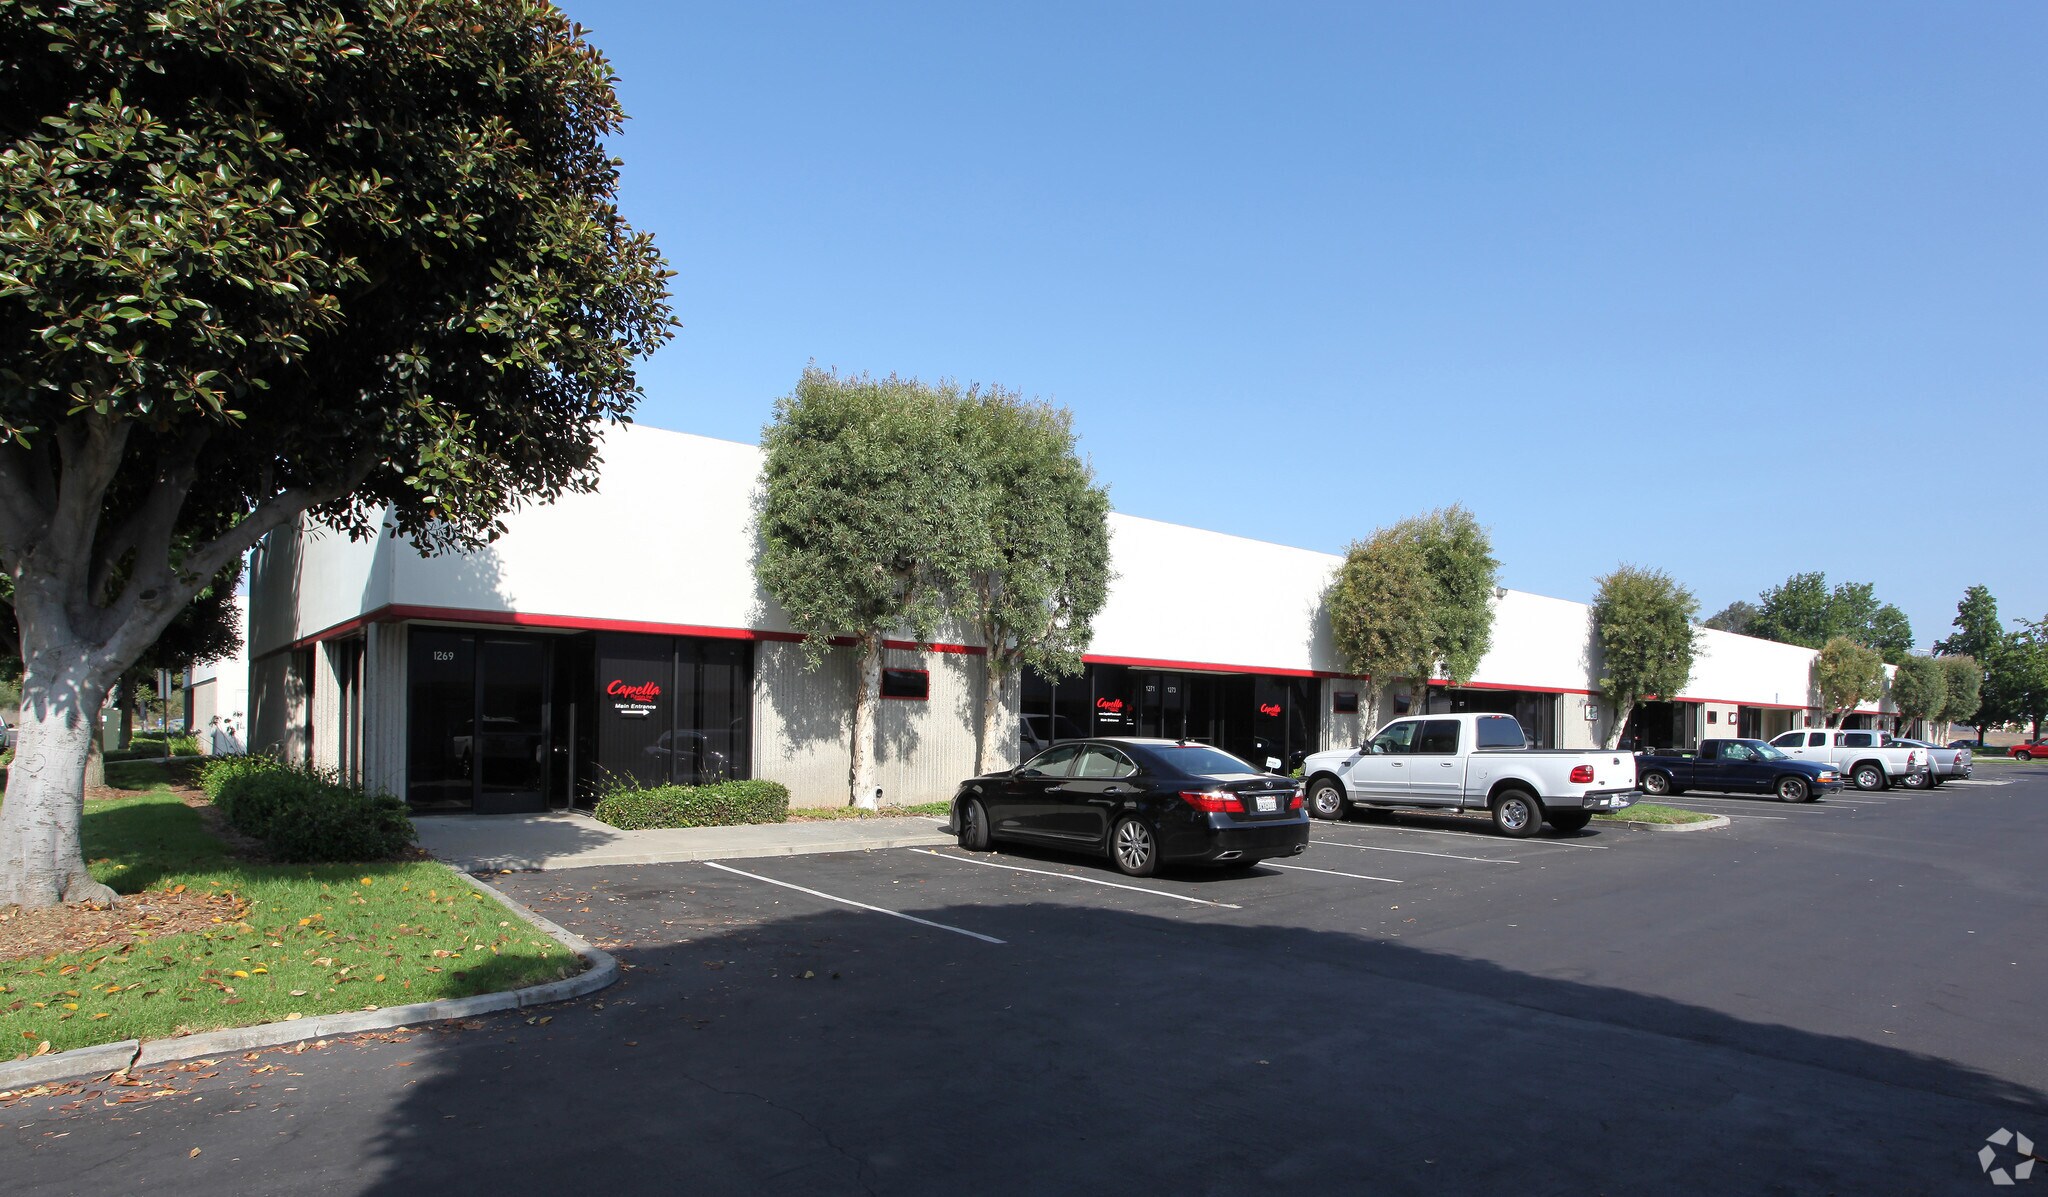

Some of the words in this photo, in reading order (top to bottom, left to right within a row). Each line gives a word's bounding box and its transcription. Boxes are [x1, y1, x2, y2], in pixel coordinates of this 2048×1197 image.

[433, 651, 454, 660] 1269
[607, 679, 661, 698] Capella
[1096, 697, 1123, 710] Capella
